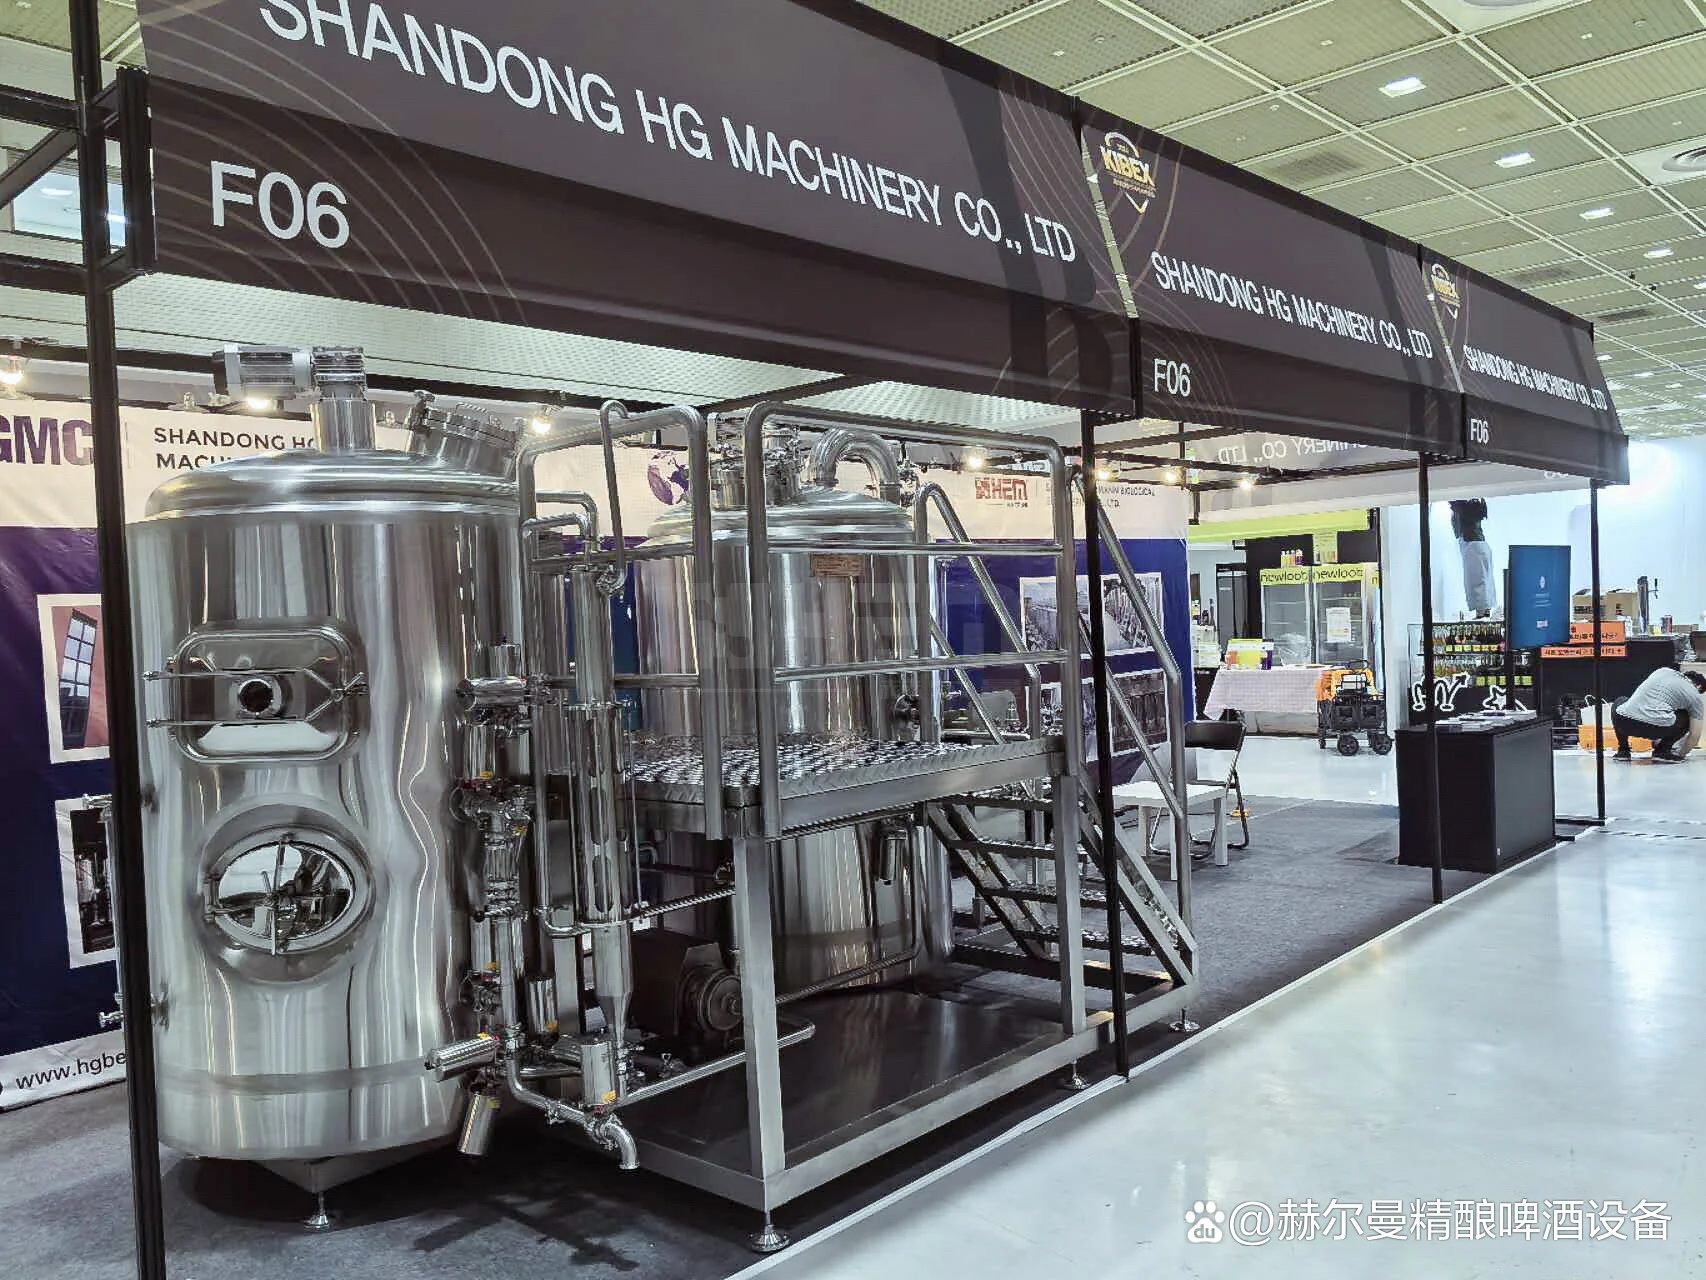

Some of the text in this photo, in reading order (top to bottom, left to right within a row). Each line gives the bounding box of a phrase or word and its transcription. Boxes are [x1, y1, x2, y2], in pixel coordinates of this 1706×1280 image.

[260, 0, 1076, 262] SHANDONG HG MACHINERY CO., LTD
[210, 160, 350, 249] F06
[1151, 250, 1433, 359] SHANDONG HG MACHINERY CO., LTD
[1154, 358, 1191, 397] F06
[1463, 344, 1521, 386] SHANDONG
[154, 427, 285, 450] SHANDONG
[1470, 418, 1490, 445] F06
